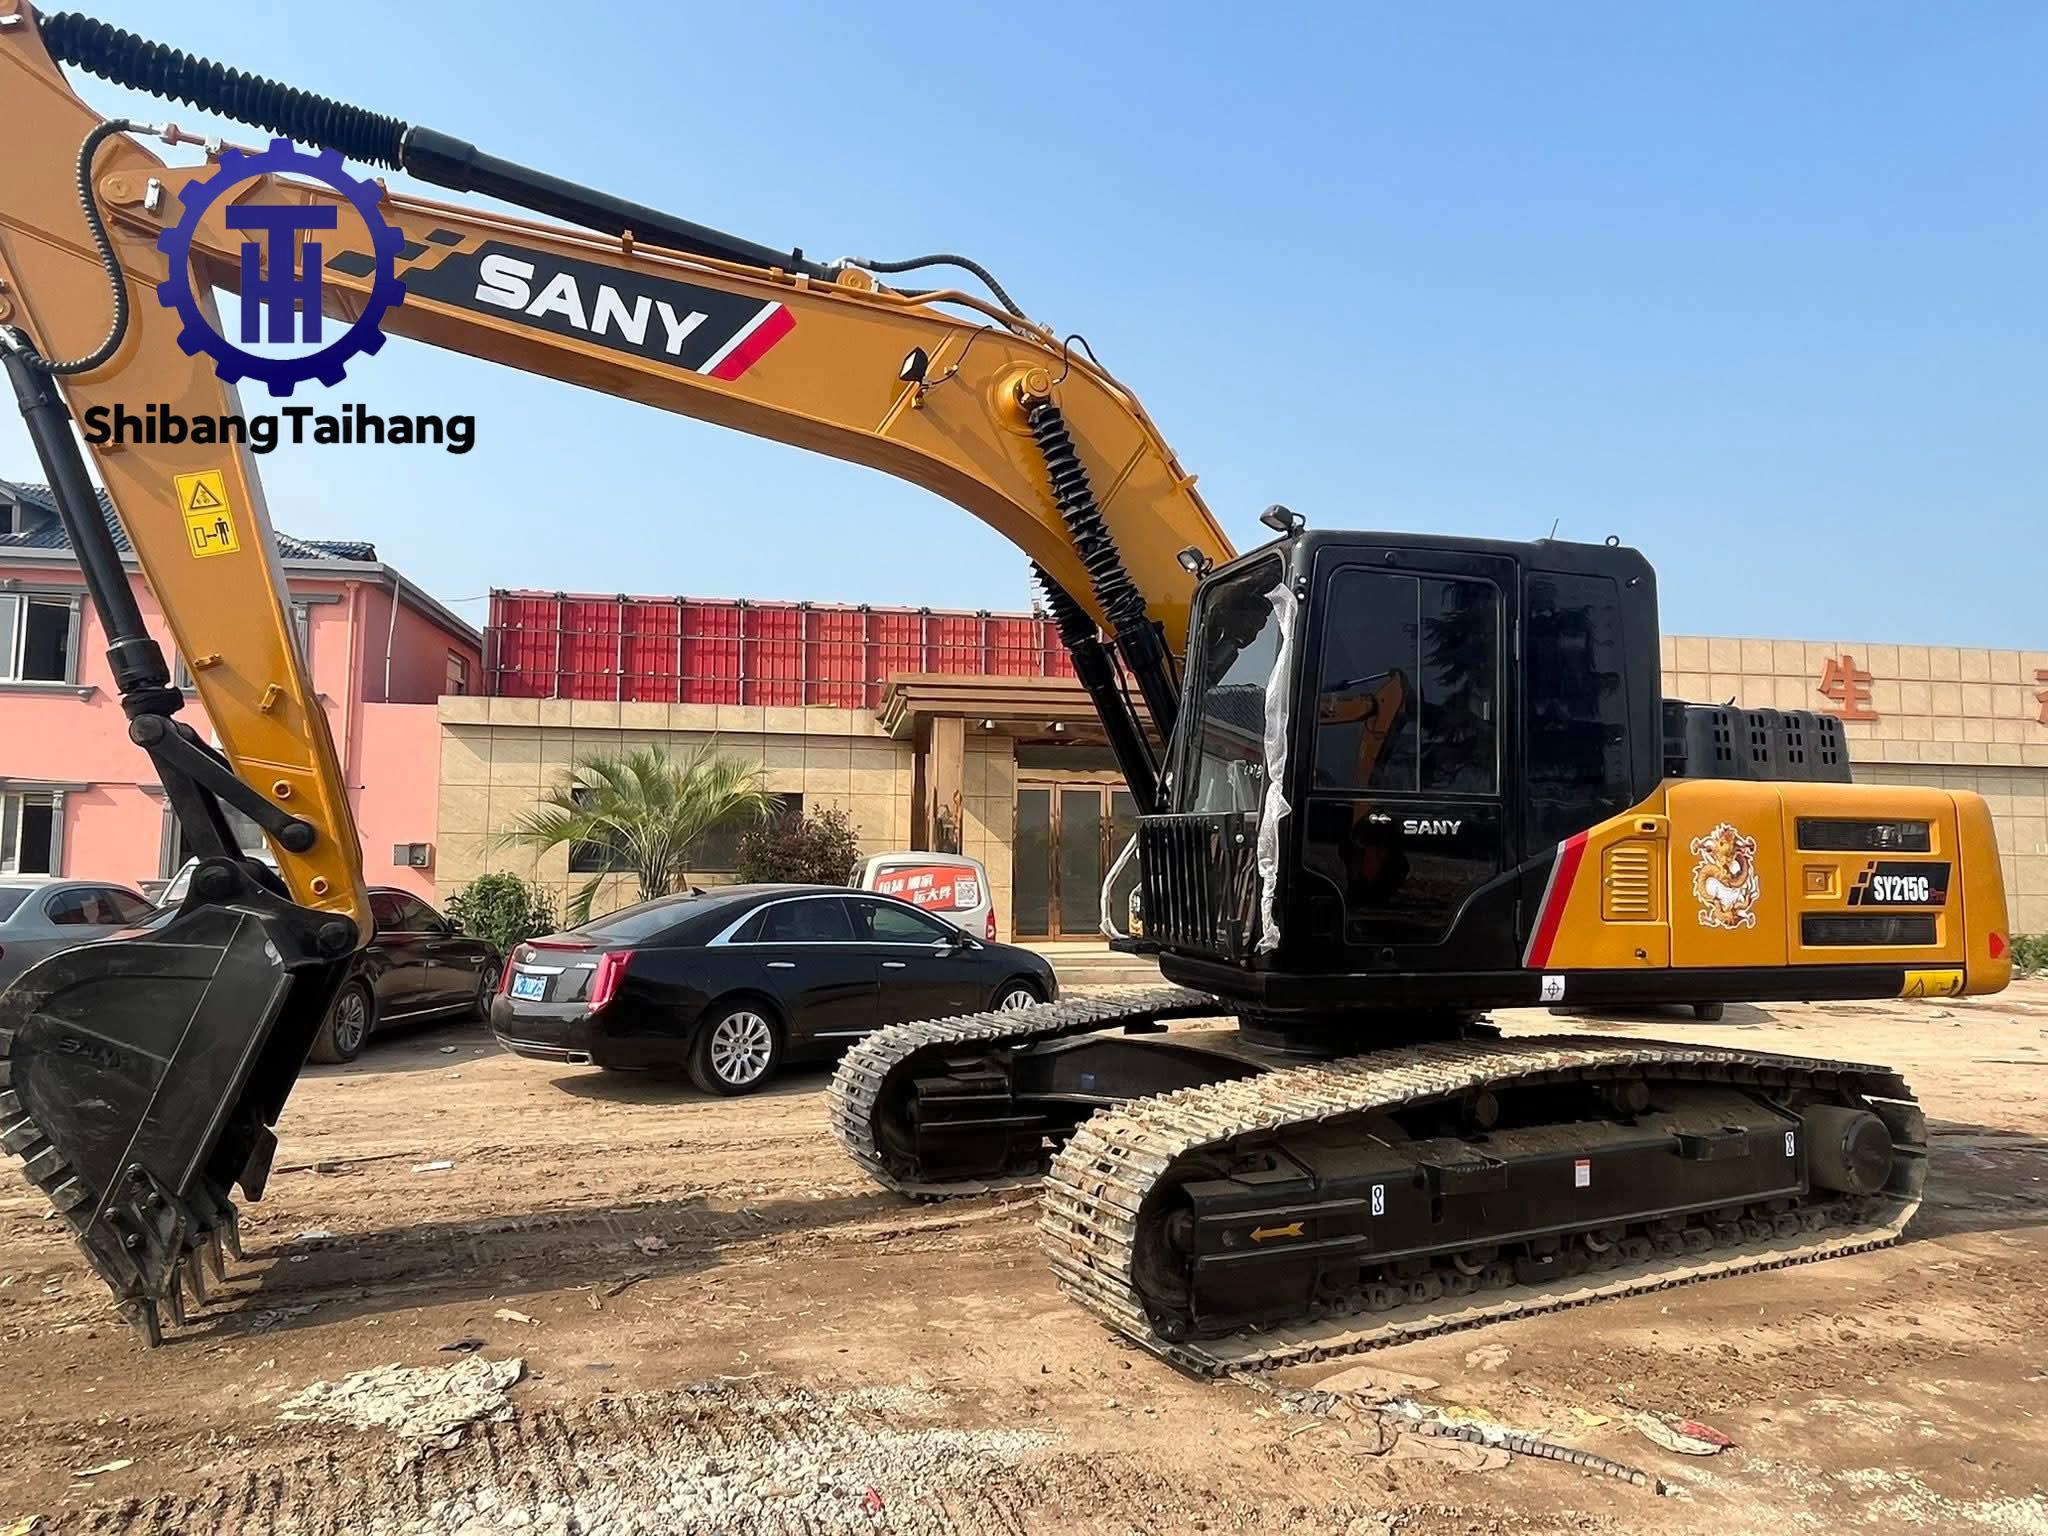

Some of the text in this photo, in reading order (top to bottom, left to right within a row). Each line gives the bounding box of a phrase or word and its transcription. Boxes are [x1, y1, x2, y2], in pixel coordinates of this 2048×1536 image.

[474, 254, 708, 356] SANY
[1817, 655, 1879, 720] 生
[1403, 820, 1462, 835] SANY
[1873, 875, 1929, 901] SY215C
